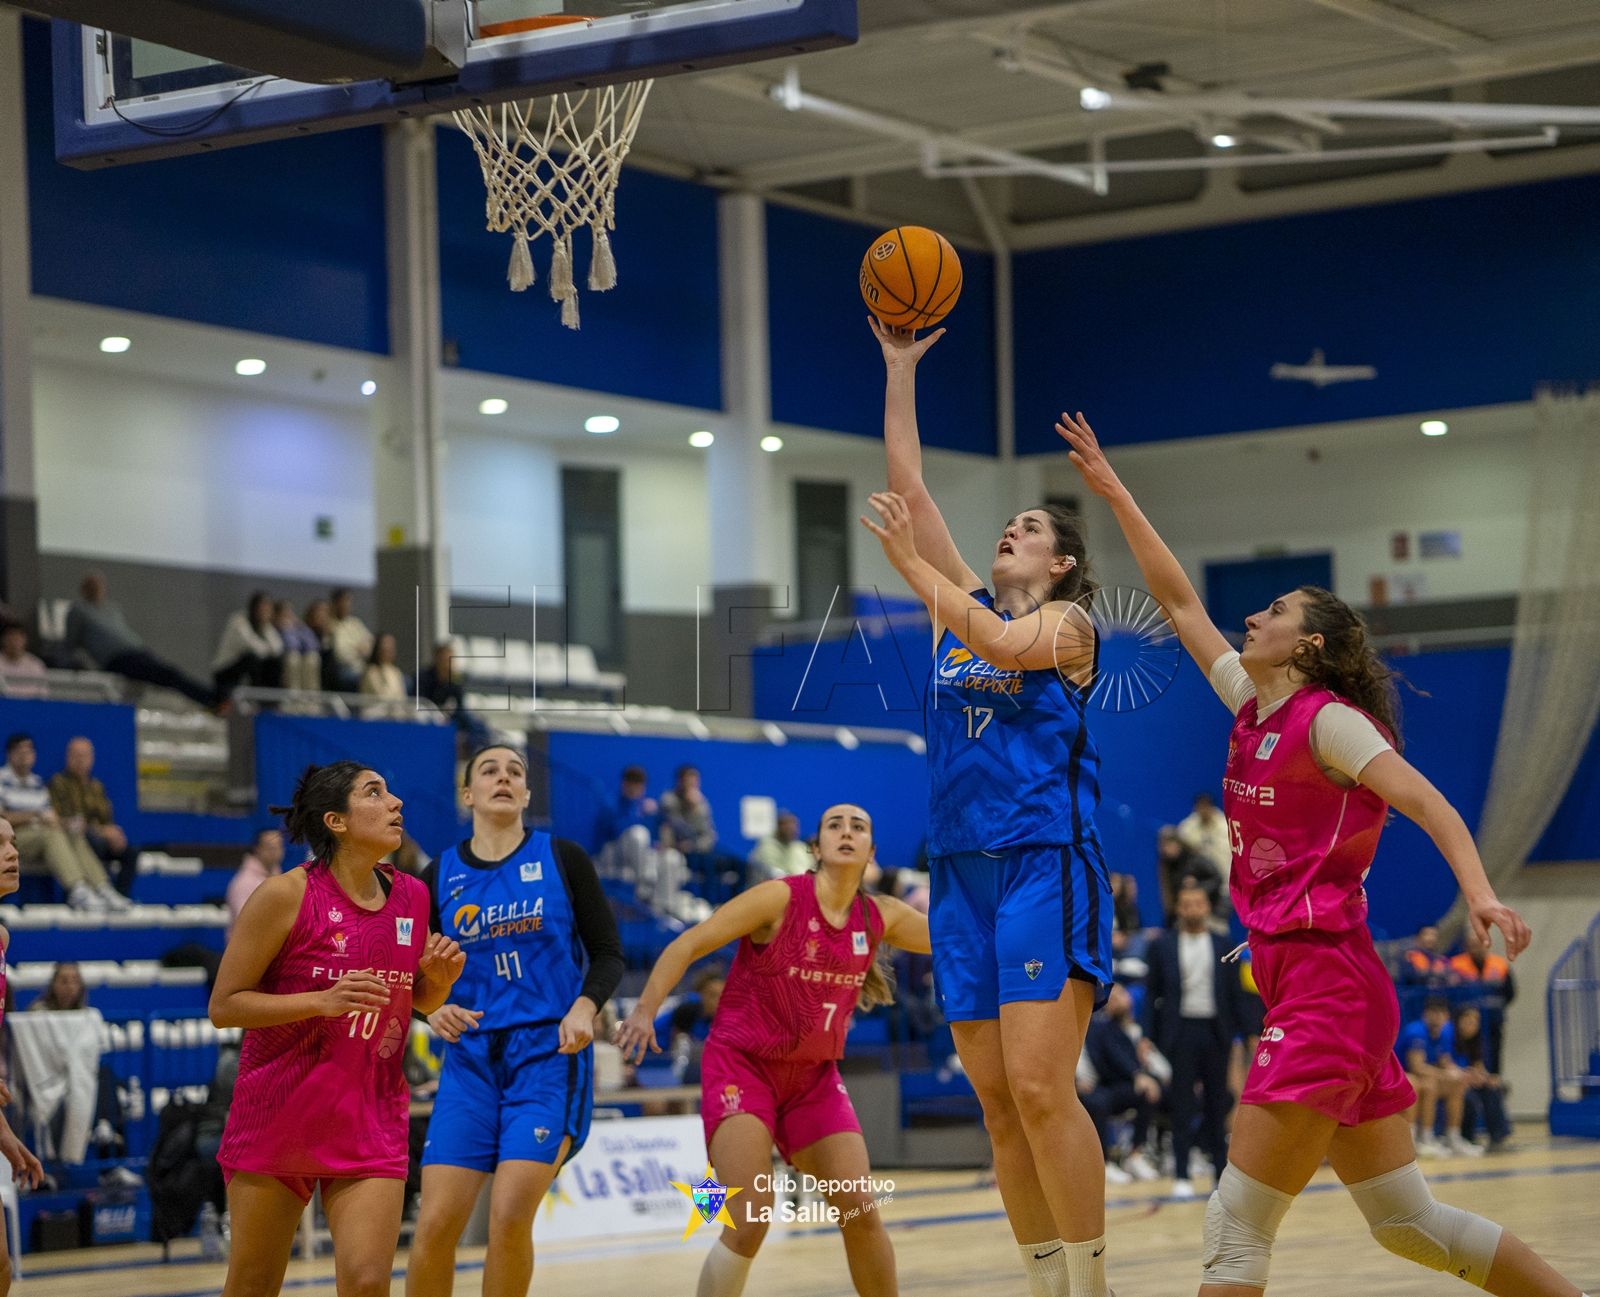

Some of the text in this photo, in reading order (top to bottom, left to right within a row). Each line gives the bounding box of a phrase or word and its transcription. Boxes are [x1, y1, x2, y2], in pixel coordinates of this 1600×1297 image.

[965, 674, 1024, 695] DEPORTE
[962, 705, 994, 739] 17
[490, 917, 544, 938] DEPORTE
[494, 950, 523, 982] 41
[347, 1009, 380, 1040] 10
[822, 1002, 838, 1032] 7
[572, 1161, 610, 1199] La
